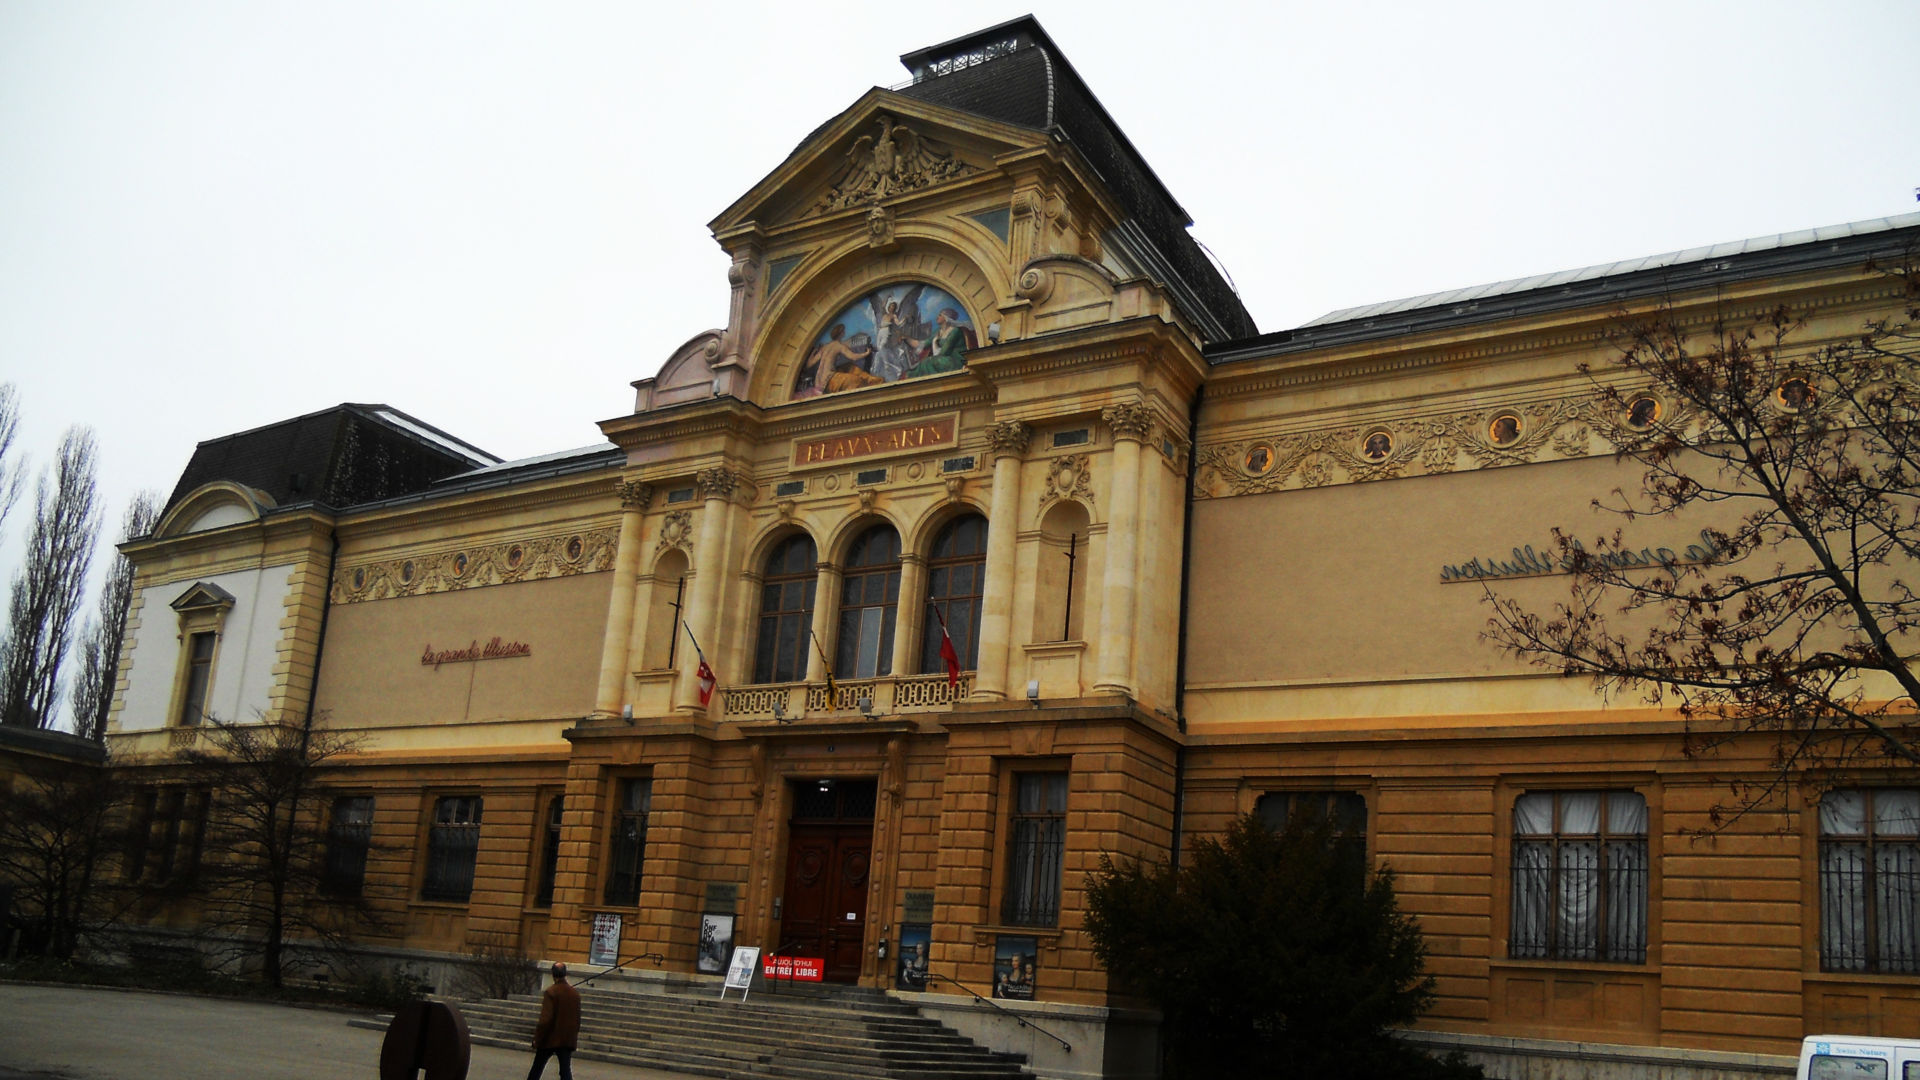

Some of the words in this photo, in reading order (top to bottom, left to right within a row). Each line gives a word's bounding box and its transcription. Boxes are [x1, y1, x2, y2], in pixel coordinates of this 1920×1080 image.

[434, 639, 481, 671] grande
[482, 636, 531, 657] illusion
[765, 965, 793, 976] ENTRÉE
[795, 967, 818, 977] LIBRE
[1859, 1048, 1888, 1056] Nature
